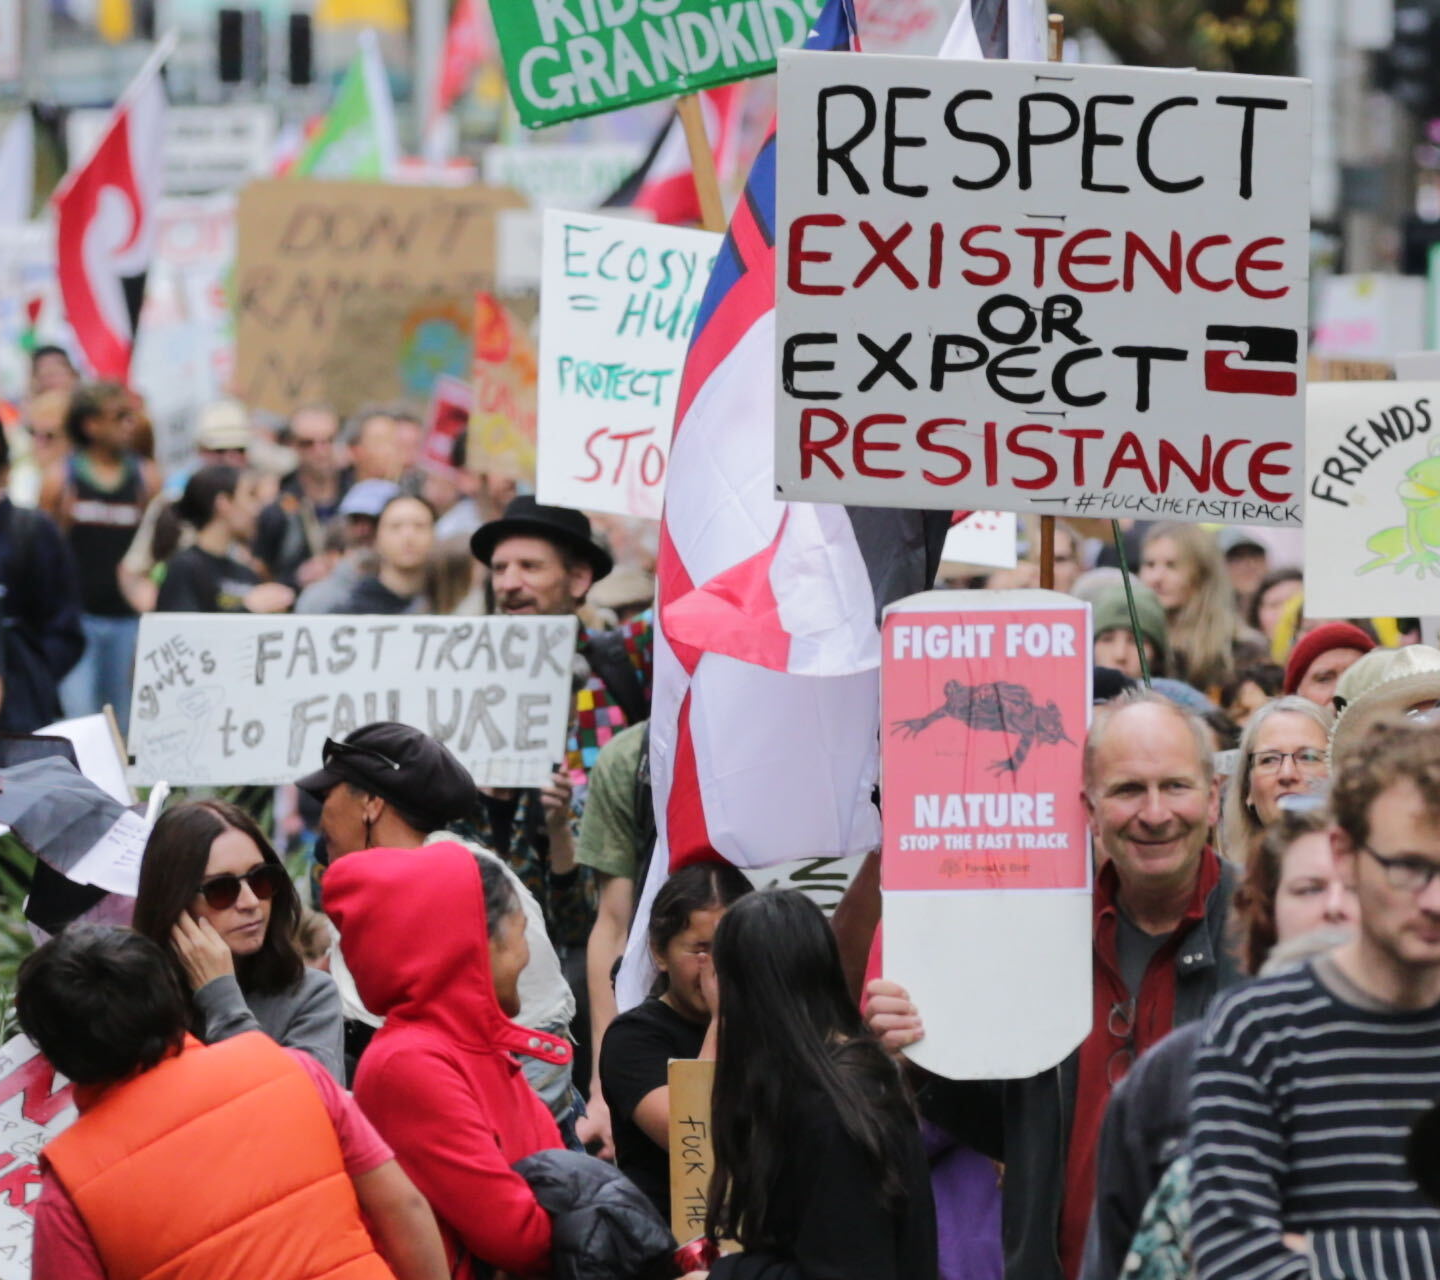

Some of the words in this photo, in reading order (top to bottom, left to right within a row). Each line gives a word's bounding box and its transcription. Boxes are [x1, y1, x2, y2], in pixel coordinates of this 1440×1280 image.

[816, 83, 1289, 200] RESPECT
[786, 213, 1292, 300] EXISTENCE
[977, 293, 1093, 345] OR
[558, 355, 675, 407] PROTECT
[781, 331, 1189, 413] EXPECT
[572, 425, 667, 487] STO
[799, 407, 1295, 504] RESISTANCE
[1311, 398, 1432, 507] FRIENDS
[1074, 491, 1304, 525] #FUCKTHEFASTTRACK
[253, 624, 402, 686] FAST
[412, 621, 574, 678] TRACK
[893, 624, 996, 660] FIGHT
[1005, 622, 1077, 658] FOR
[217, 706, 266, 758] to
[914, 792, 1056, 829] NATURE
[899, 833, 940, 852] STOP
[944, 833, 973, 850] THE
[976, 833, 1014, 850] FAST
[1016, 832, 1069, 850] TRACK
[678, 1114, 706, 1176] FUCK
